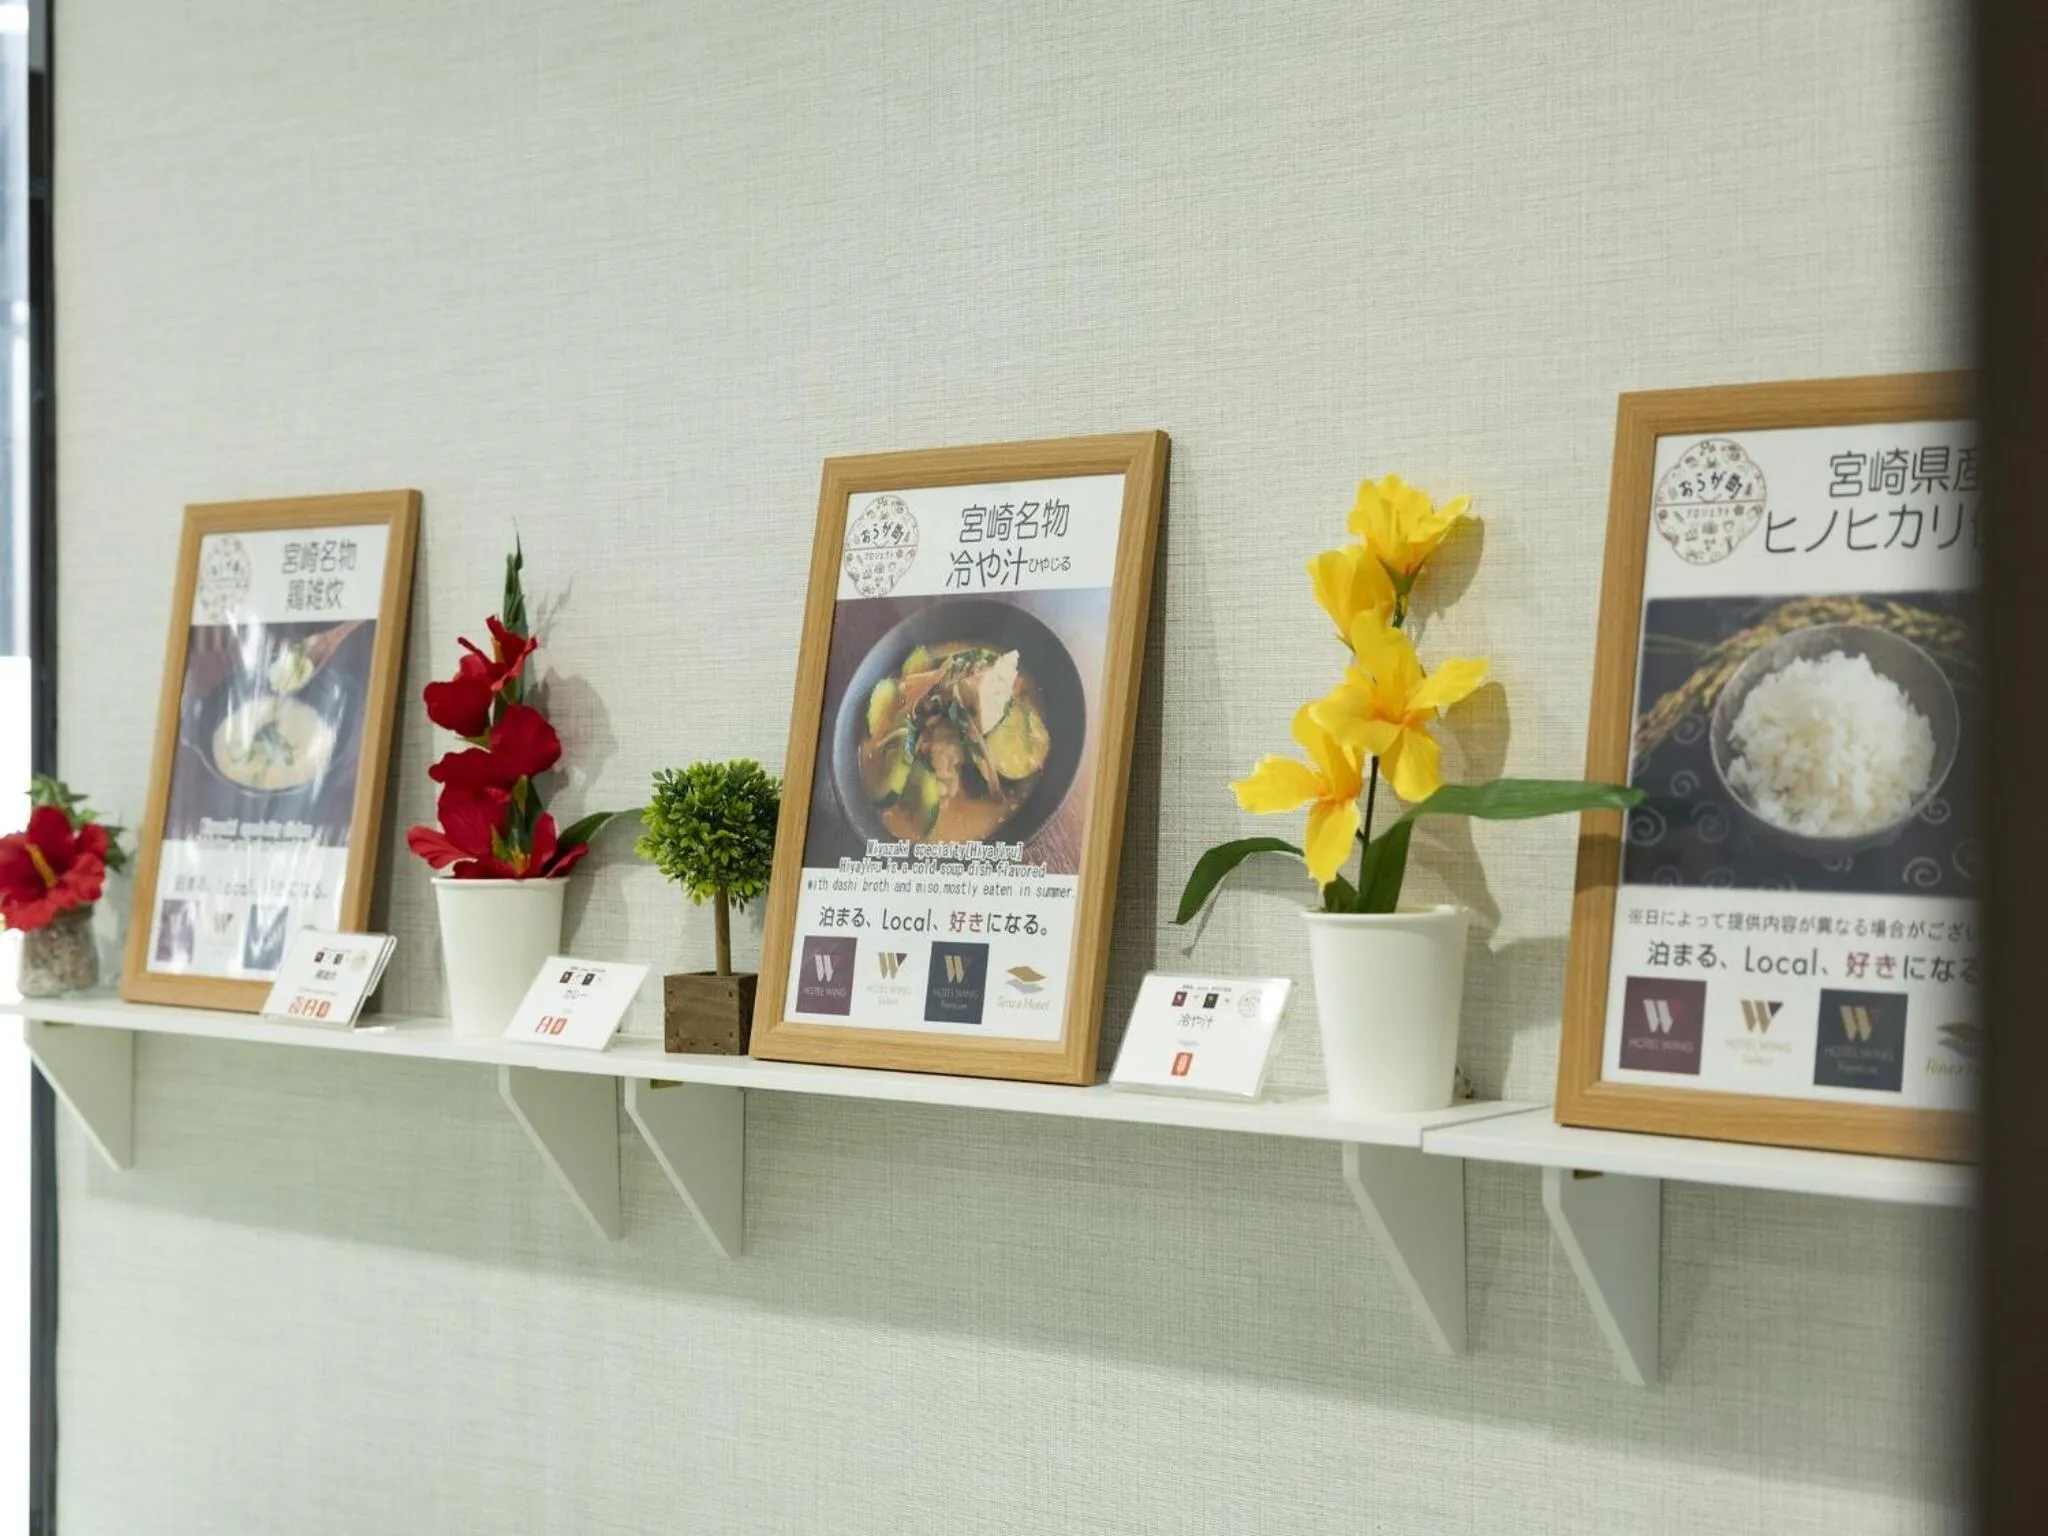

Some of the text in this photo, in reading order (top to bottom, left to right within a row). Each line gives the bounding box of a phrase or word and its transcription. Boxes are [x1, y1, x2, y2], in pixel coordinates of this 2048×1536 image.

[960, 498, 1069, 543] 宮崎名物
[282, 539, 357, 574] 宮崎名物
[887, 859, 897, 873] is
[901, 863, 908, 874] a
[912, 860, 936, 875] cold
[941, 863, 963, 878] soup
[968, 861, 992, 877] dish
[996, 861, 1046, 878] flavored
[808, 880, 828, 891] with
[833, 879, 857, 892] dashi
[862, 879, 889, 893] broth
[894, 880, 911, 893] and
[983, 884, 1013, 896] eaten
[1020, 884, 1031, 896] in
